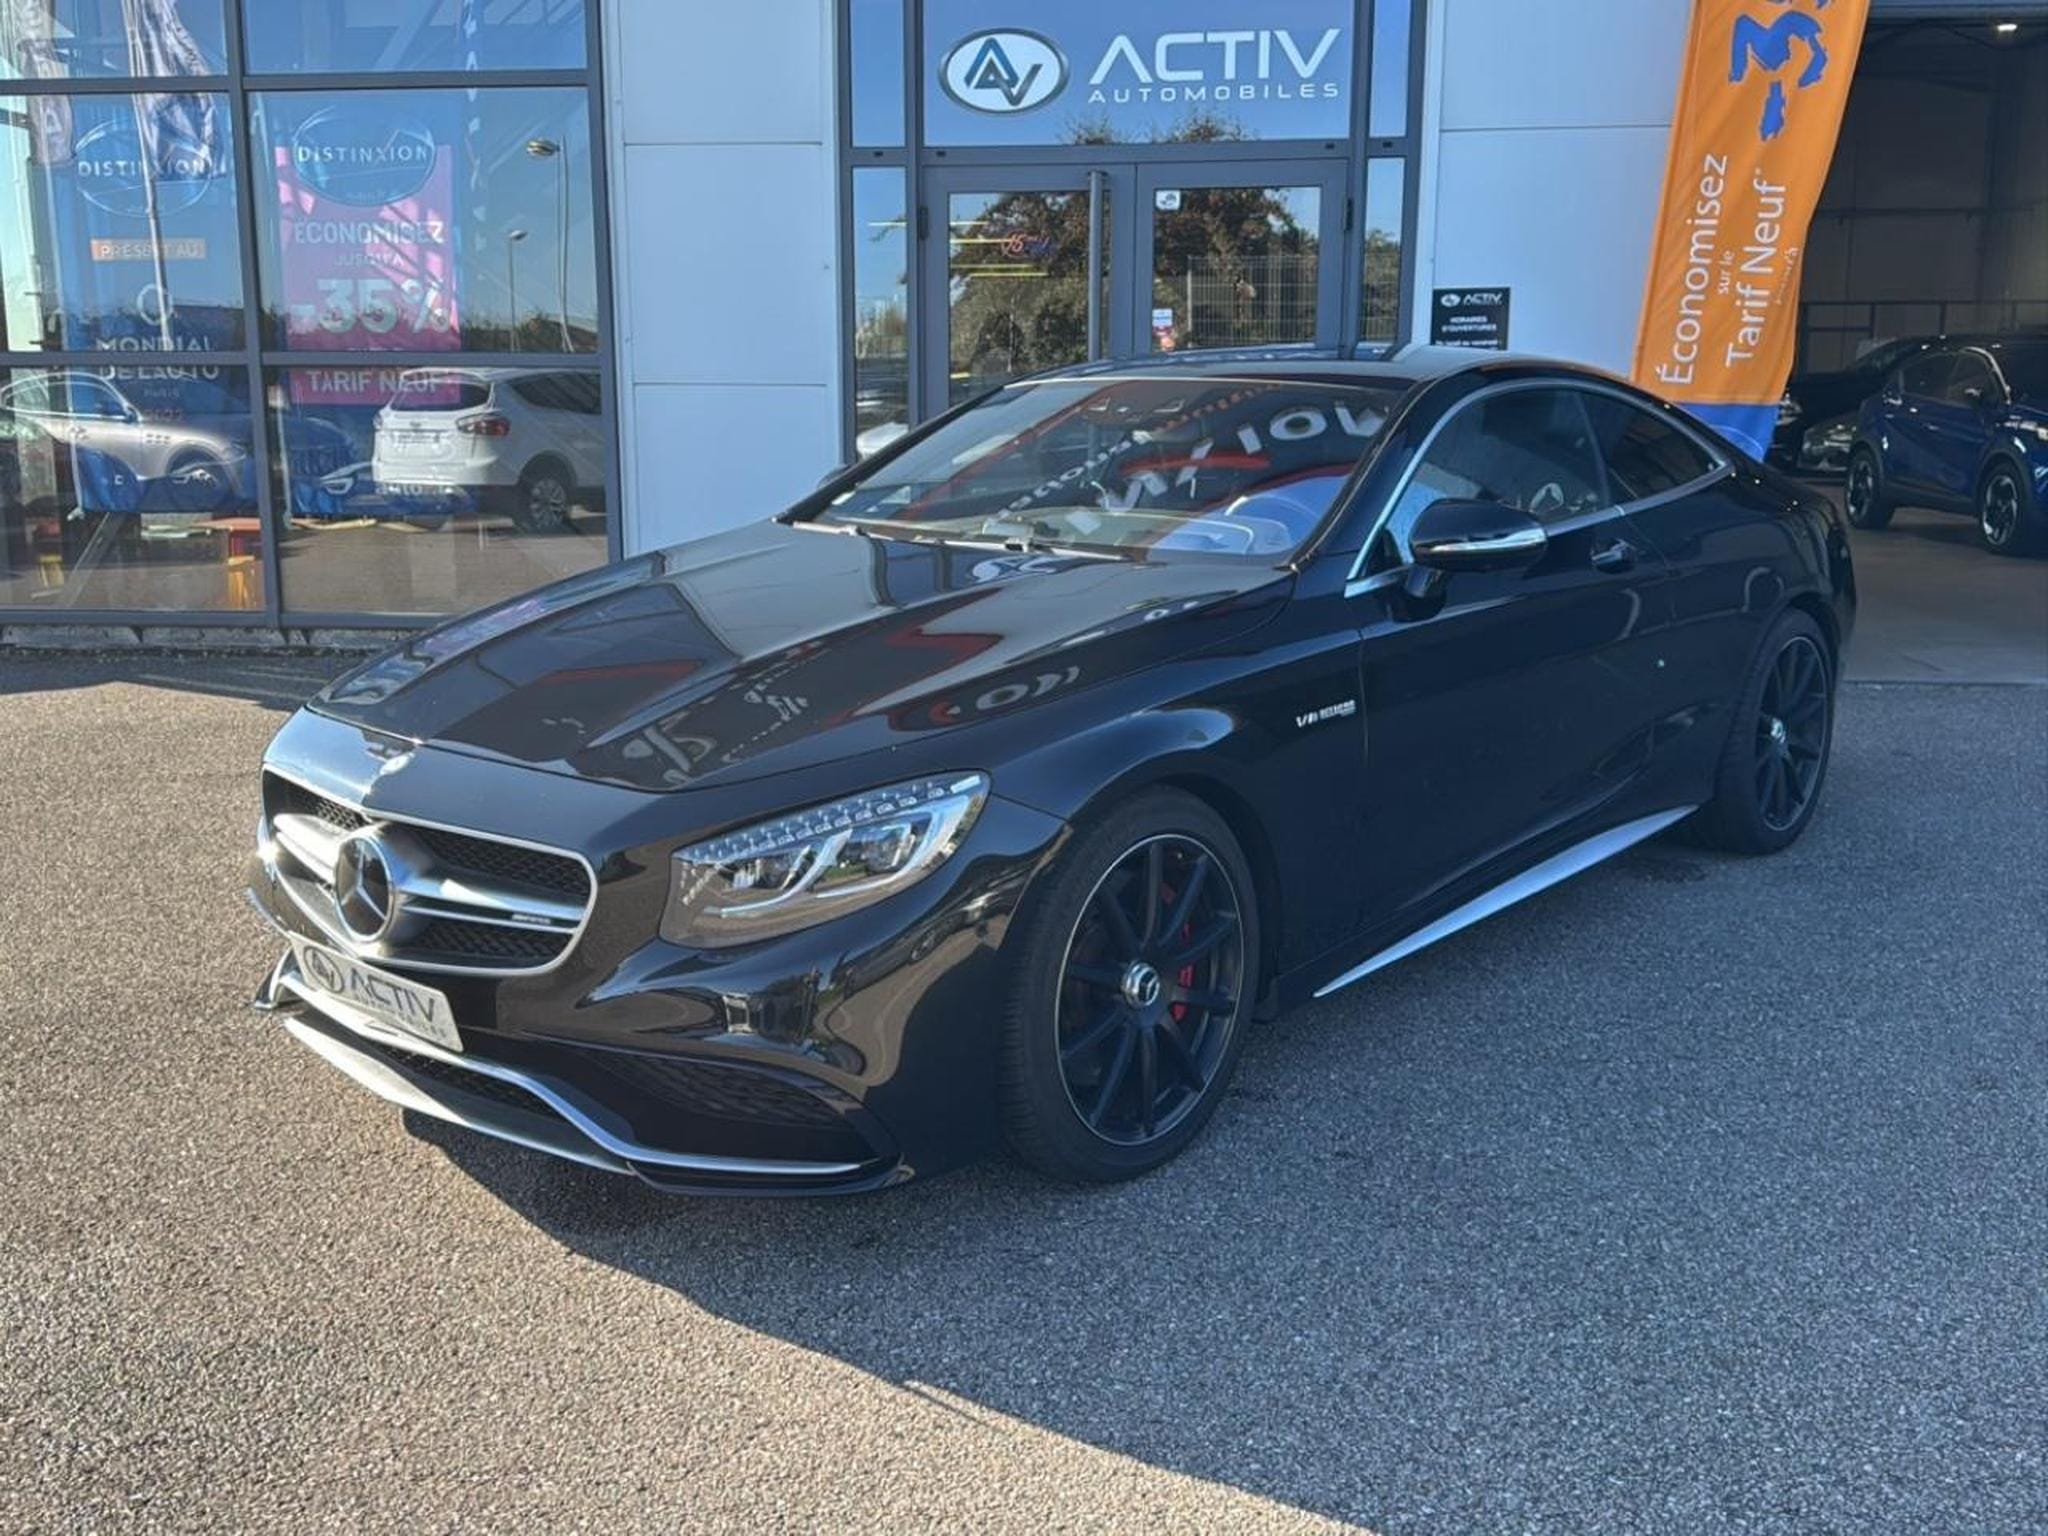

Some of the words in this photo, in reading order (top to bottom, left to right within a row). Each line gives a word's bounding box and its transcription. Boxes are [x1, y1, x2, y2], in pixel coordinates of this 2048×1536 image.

[1089, 28, 1341, 85] ACTIV
[1728, 0, 1832, 142] -3
[1088, 83, 1339, 104] AUTOMOBILES
[299, 146, 427, 163] DISTINXION
[1655, 153, 1727, 384] Économisez
[289, 278, 451, 334] -35%
[1725, 281, 1771, 368] Tarif
[305, 371, 374, 392] TARIF
[351, 967, 434, 1023] ACTIV
